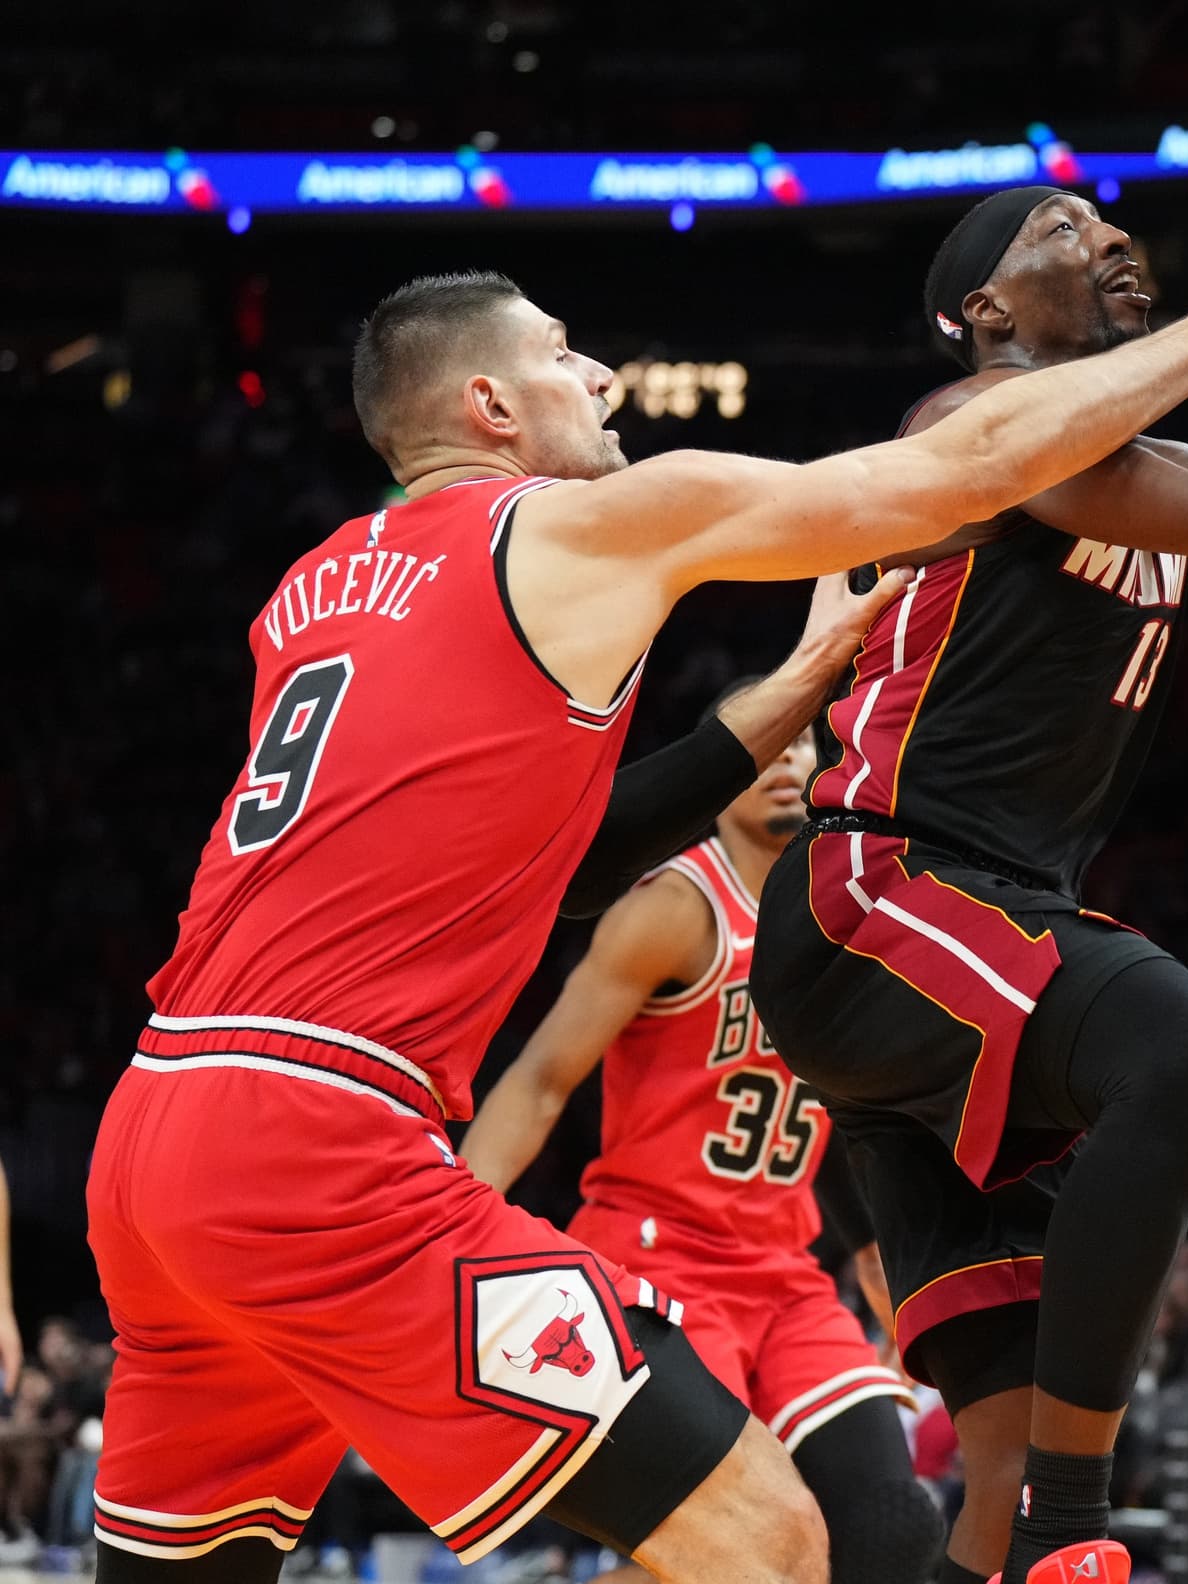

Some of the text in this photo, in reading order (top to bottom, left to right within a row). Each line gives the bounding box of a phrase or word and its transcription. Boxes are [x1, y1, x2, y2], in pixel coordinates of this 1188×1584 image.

[3, 155, 171, 203] American
[299, 159, 465, 203] American
[591, 158, 758, 202] American
[877, 141, 1038, 191] American
[1110, 617, 1172, 711] 13
[227, 652, 355, 856] 9
[701, 1065, 821, 1186] 35
